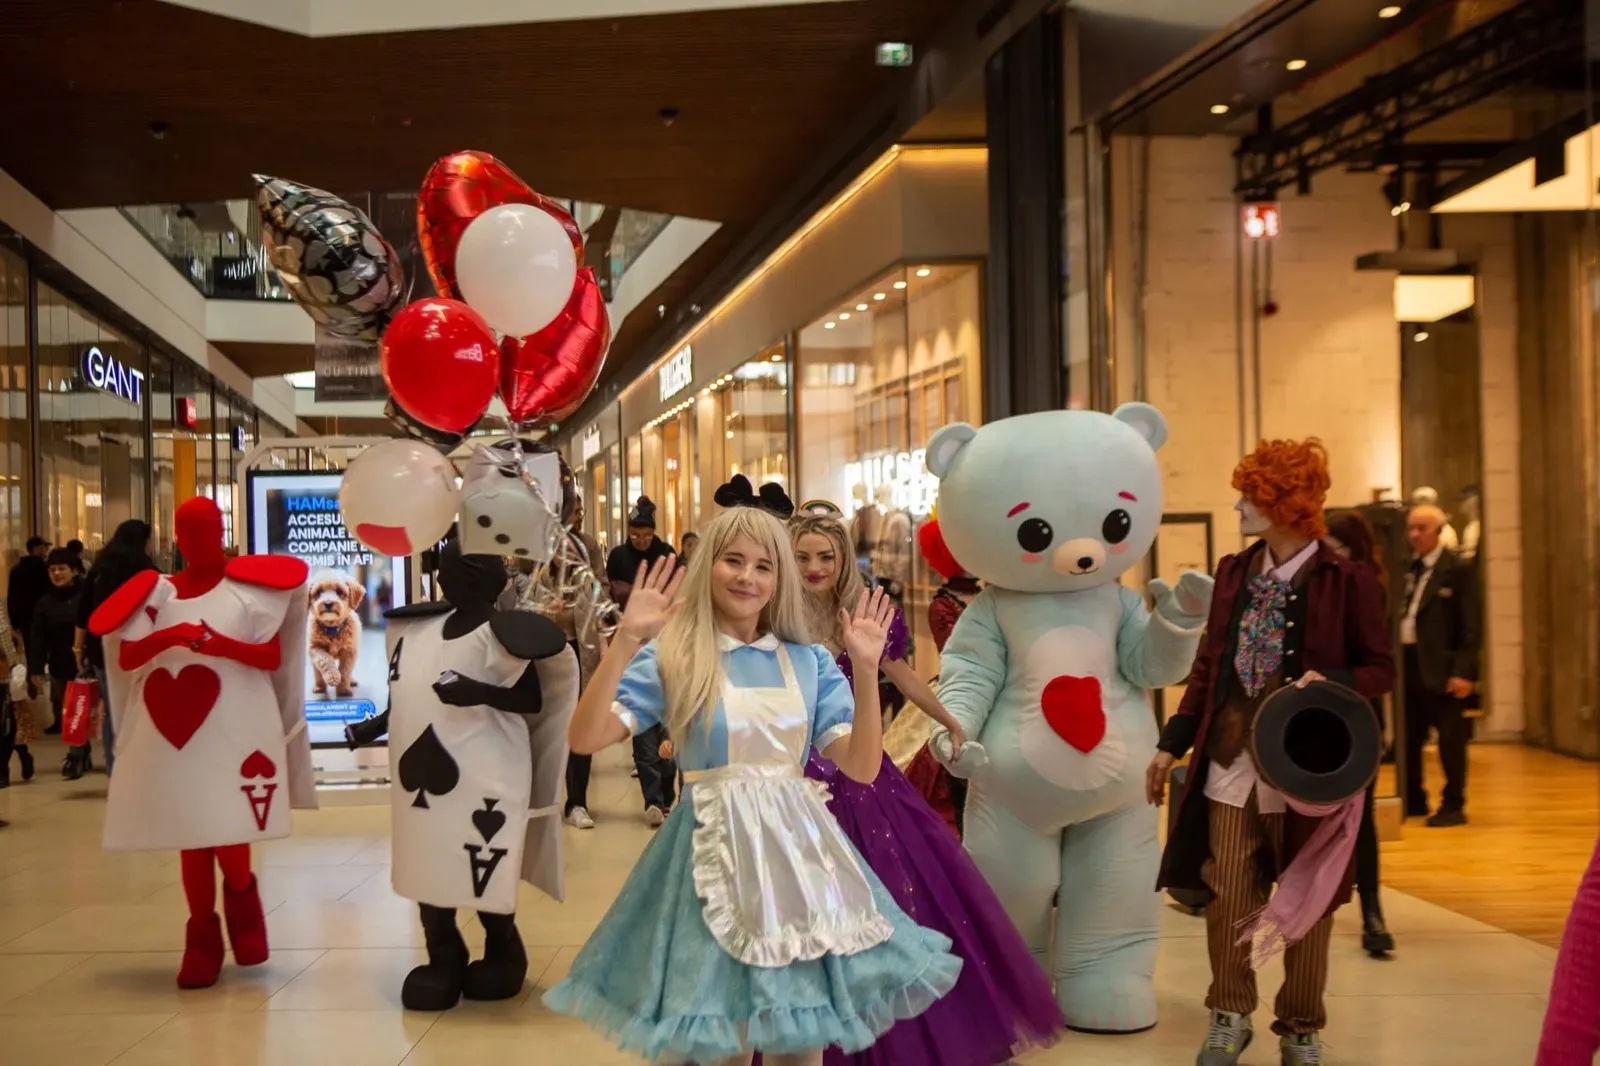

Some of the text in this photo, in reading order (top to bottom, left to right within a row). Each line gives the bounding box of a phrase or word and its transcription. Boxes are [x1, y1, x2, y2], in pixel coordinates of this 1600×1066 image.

[87, 346, 144, 405] GANT
[288, 527, 346, 540] ANIMALE
[288, 540, 358, 553] COMPANIE
[305, 554, 335, 567] RMIS
[354, 554, 373, 566] AFI
[388, 636, 404, 685] A
[240, 783, 277, 831] A
[463, 843, 508, 899] A
